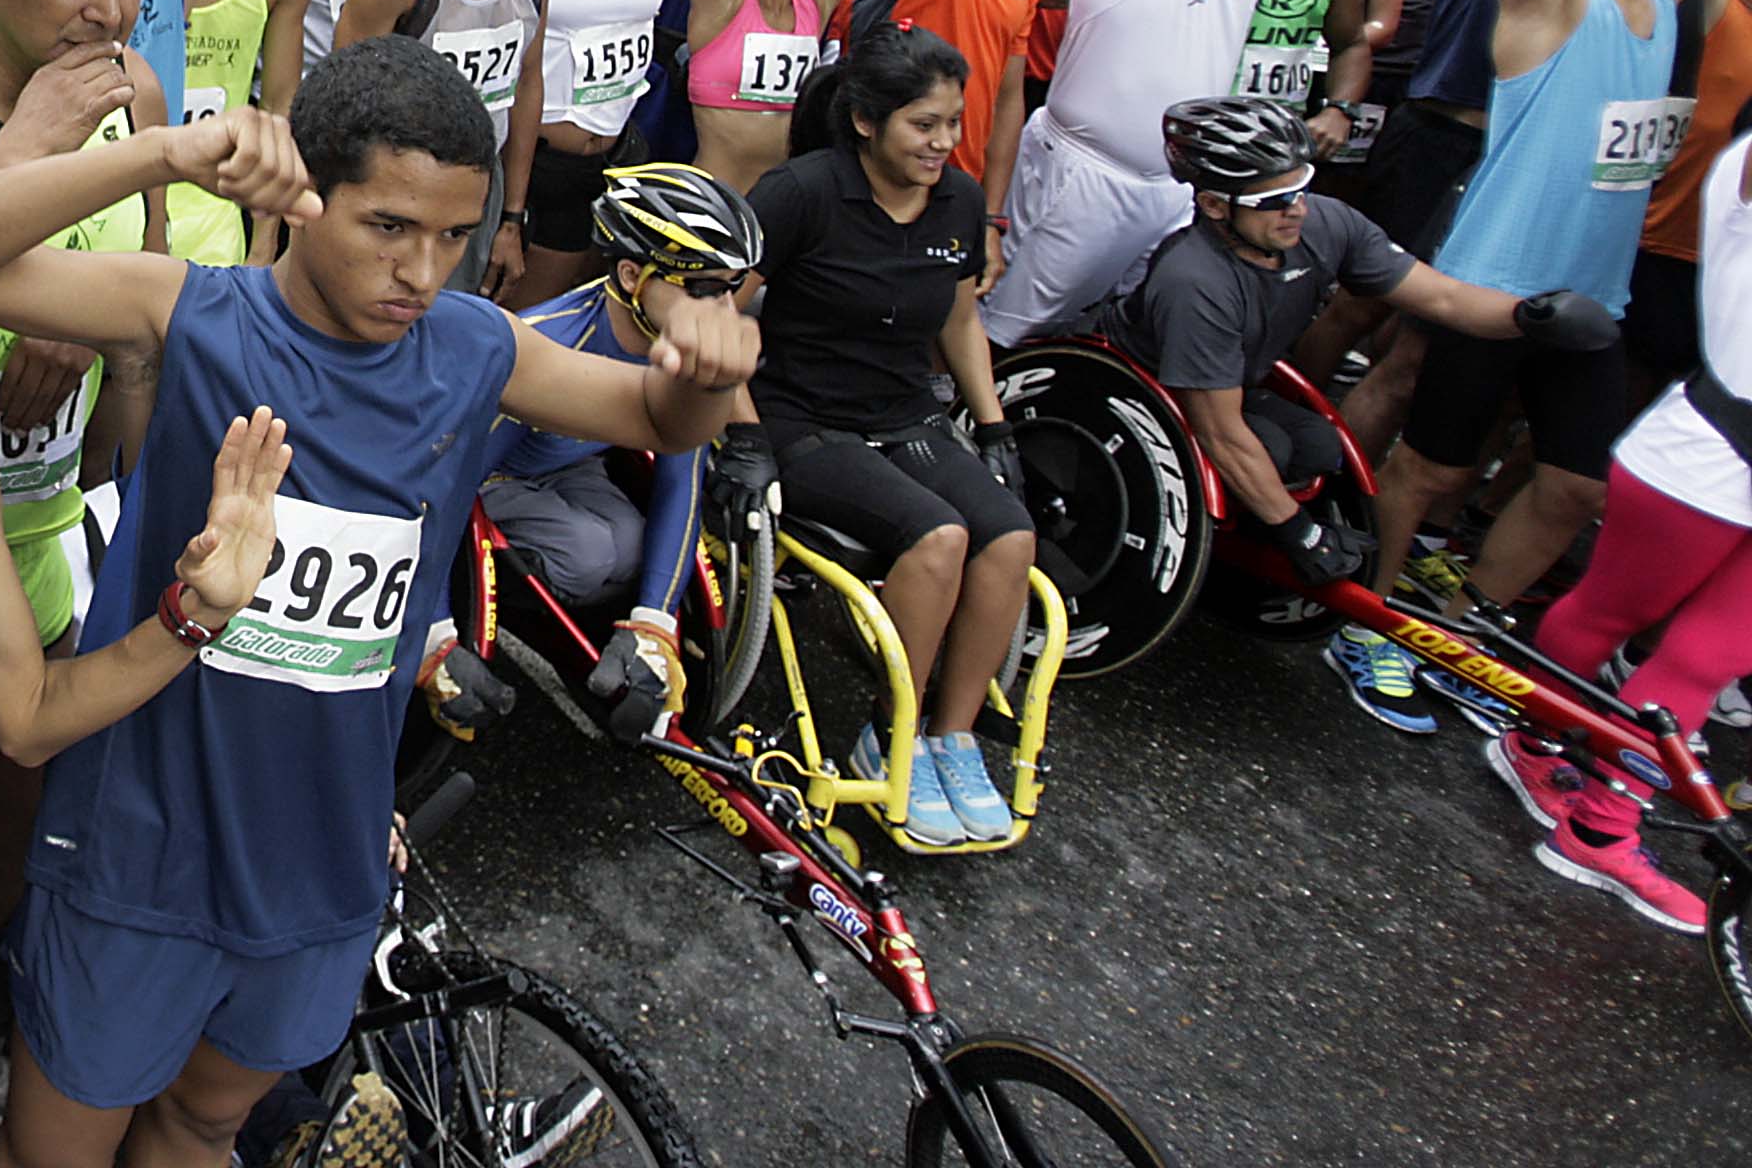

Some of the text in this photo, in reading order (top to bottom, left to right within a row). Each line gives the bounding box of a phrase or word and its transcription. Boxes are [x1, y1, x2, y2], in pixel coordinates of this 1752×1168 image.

[583, 34, 650, 82] 1559
[750, 53, 819, 92] 137
[222, 627, 341, 667] Gatorade
[1396, 619, 1537, 696] TOP END
